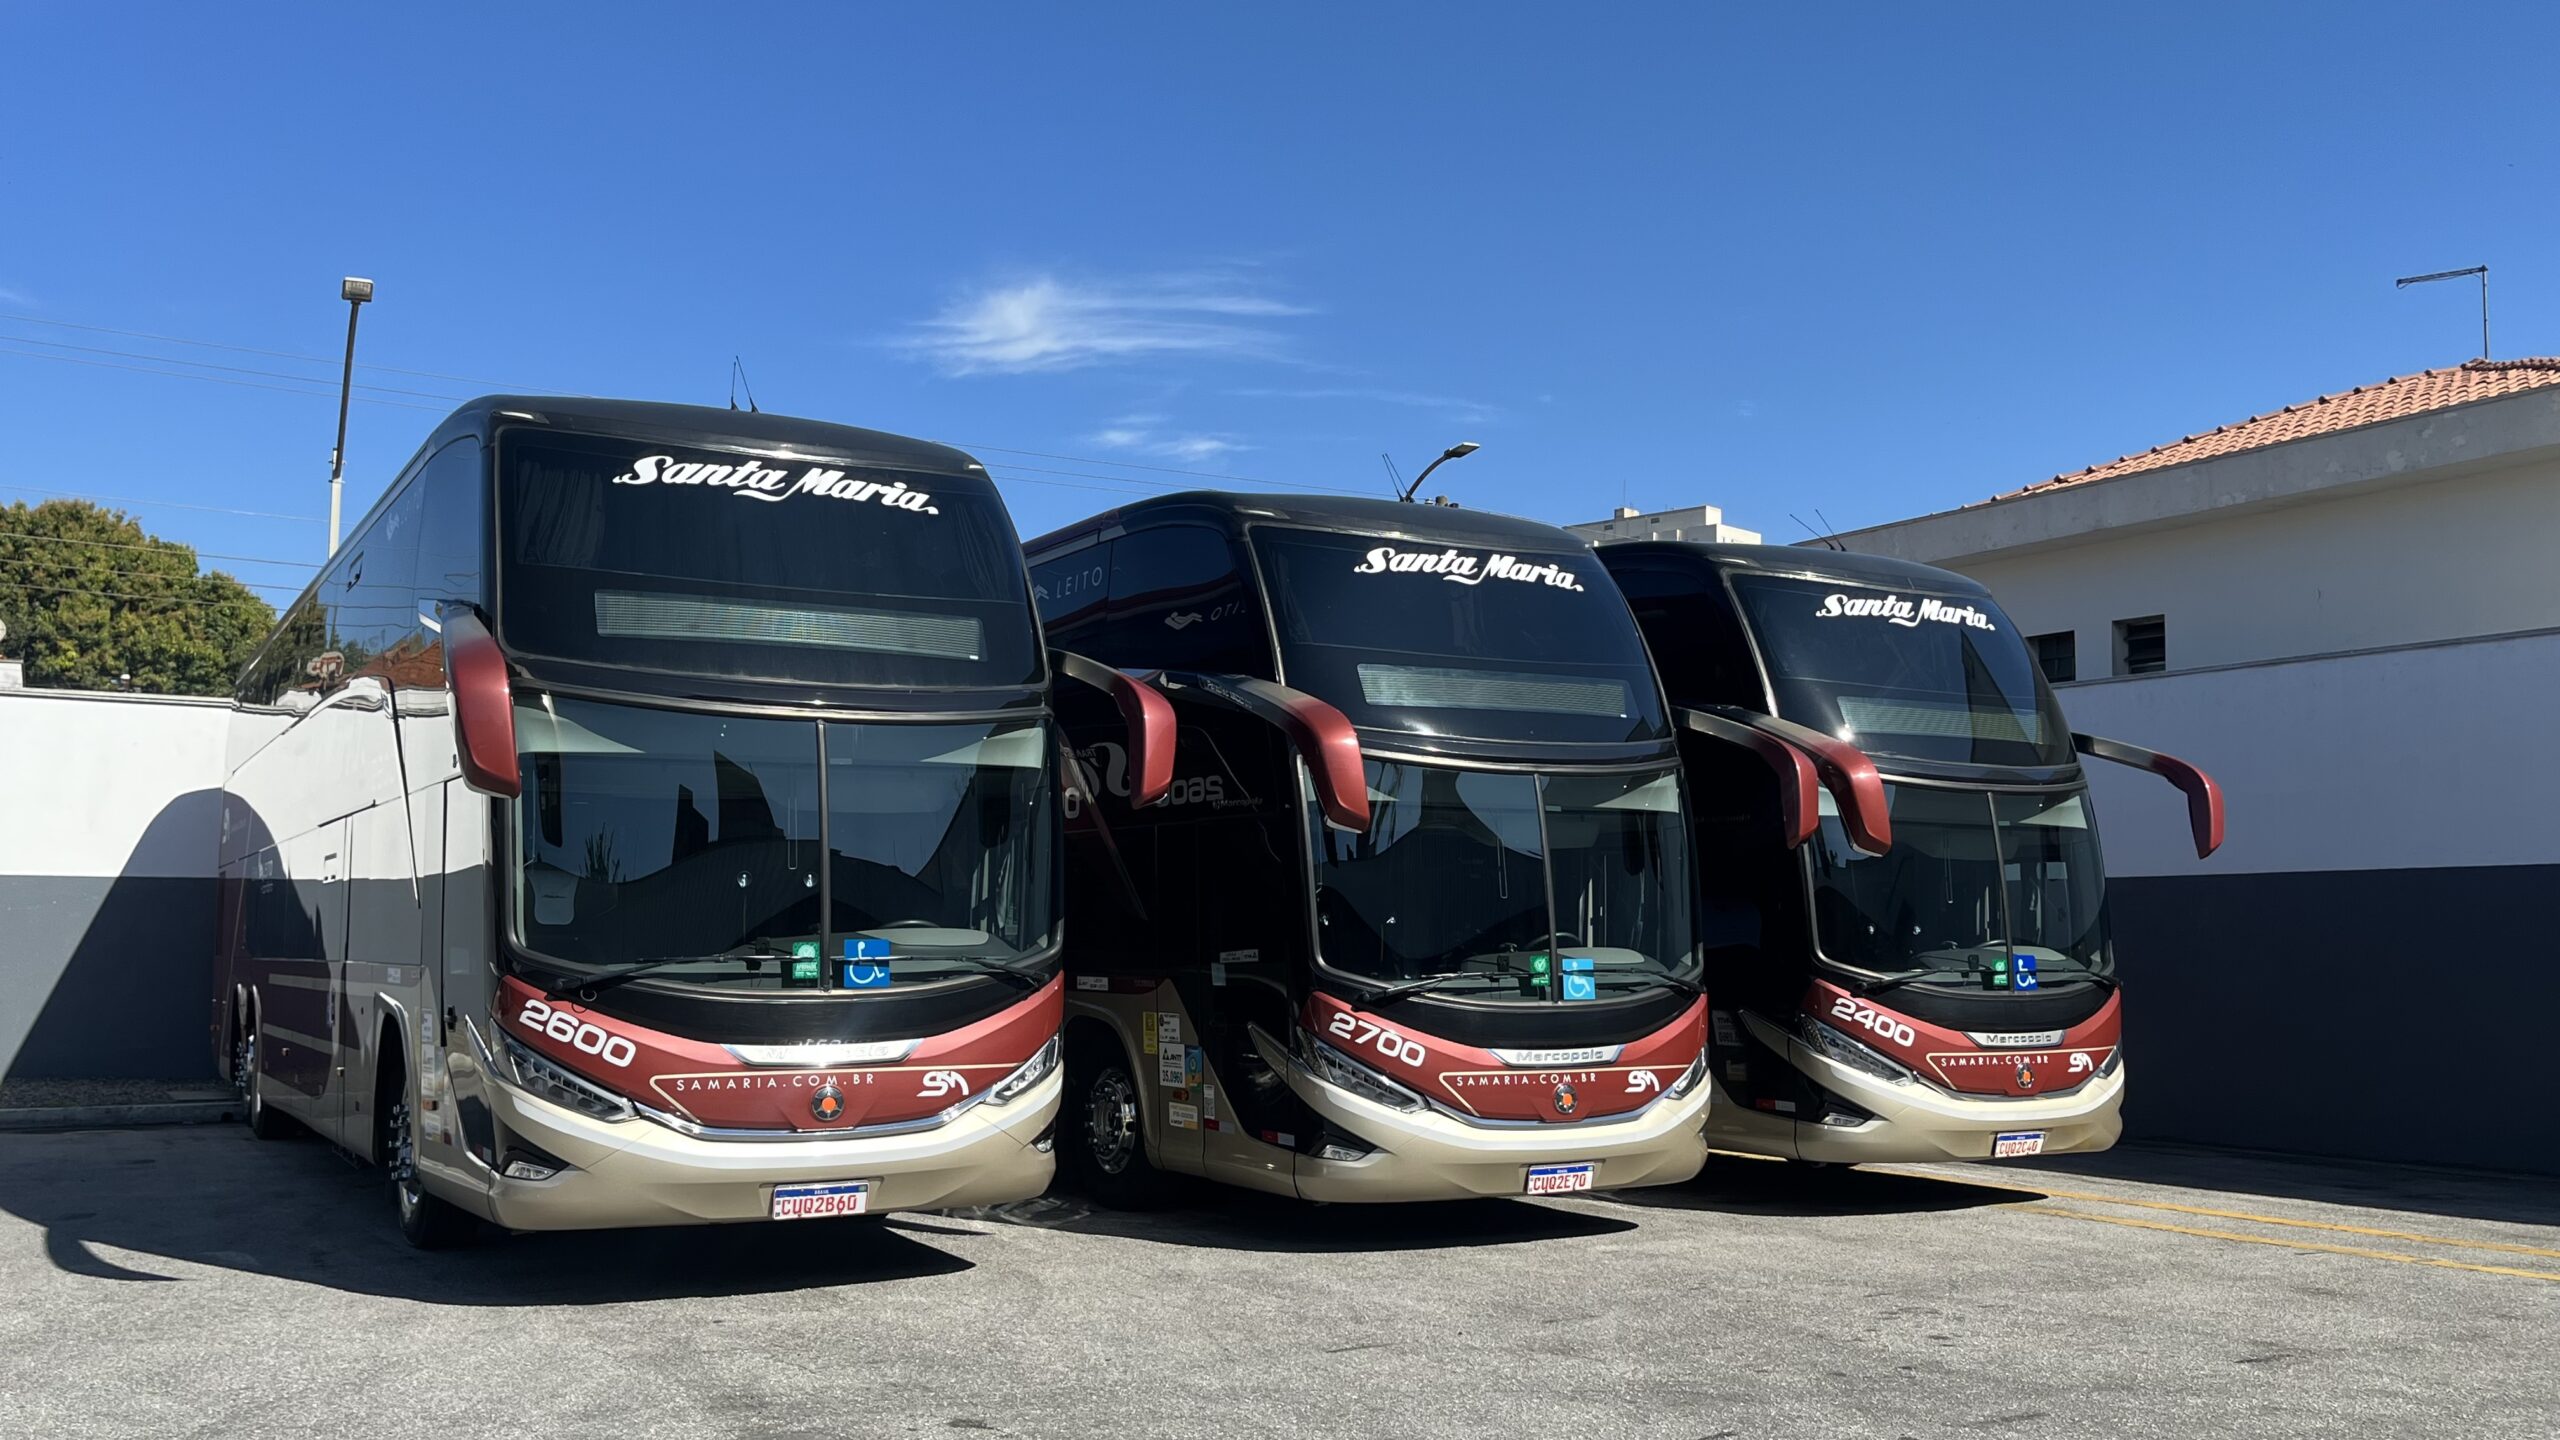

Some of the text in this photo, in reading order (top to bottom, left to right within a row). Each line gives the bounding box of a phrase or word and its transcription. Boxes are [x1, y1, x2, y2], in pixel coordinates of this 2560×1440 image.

[612, 454, 940, 516] Santa Maria
[1056, 566, 1103, 599] LEITO
[1354, 547, 1584, 592] Santa Maria
[1816, 594, 1996, 631] Santa Maria
[518, 998, 637, 1068] 2600
[1830, 997, 1916, 1047] 2400
[1328, 1011, 1427, 1068] 2700
[1515, 1048, 1605, 1063] Marcopolo
[1940, 1054, 2050, 1067] SAMARIA.COM.BR
[675, 1072, 876, 1091] SAMARIA.COM.BR
[1456, 1072, 1597, 1087] SAMARIA.COM.BR
[1533, 1173, 1587, 1191] CUQ2E70
[781, 1195, 858, 1216] CUQ2B60
